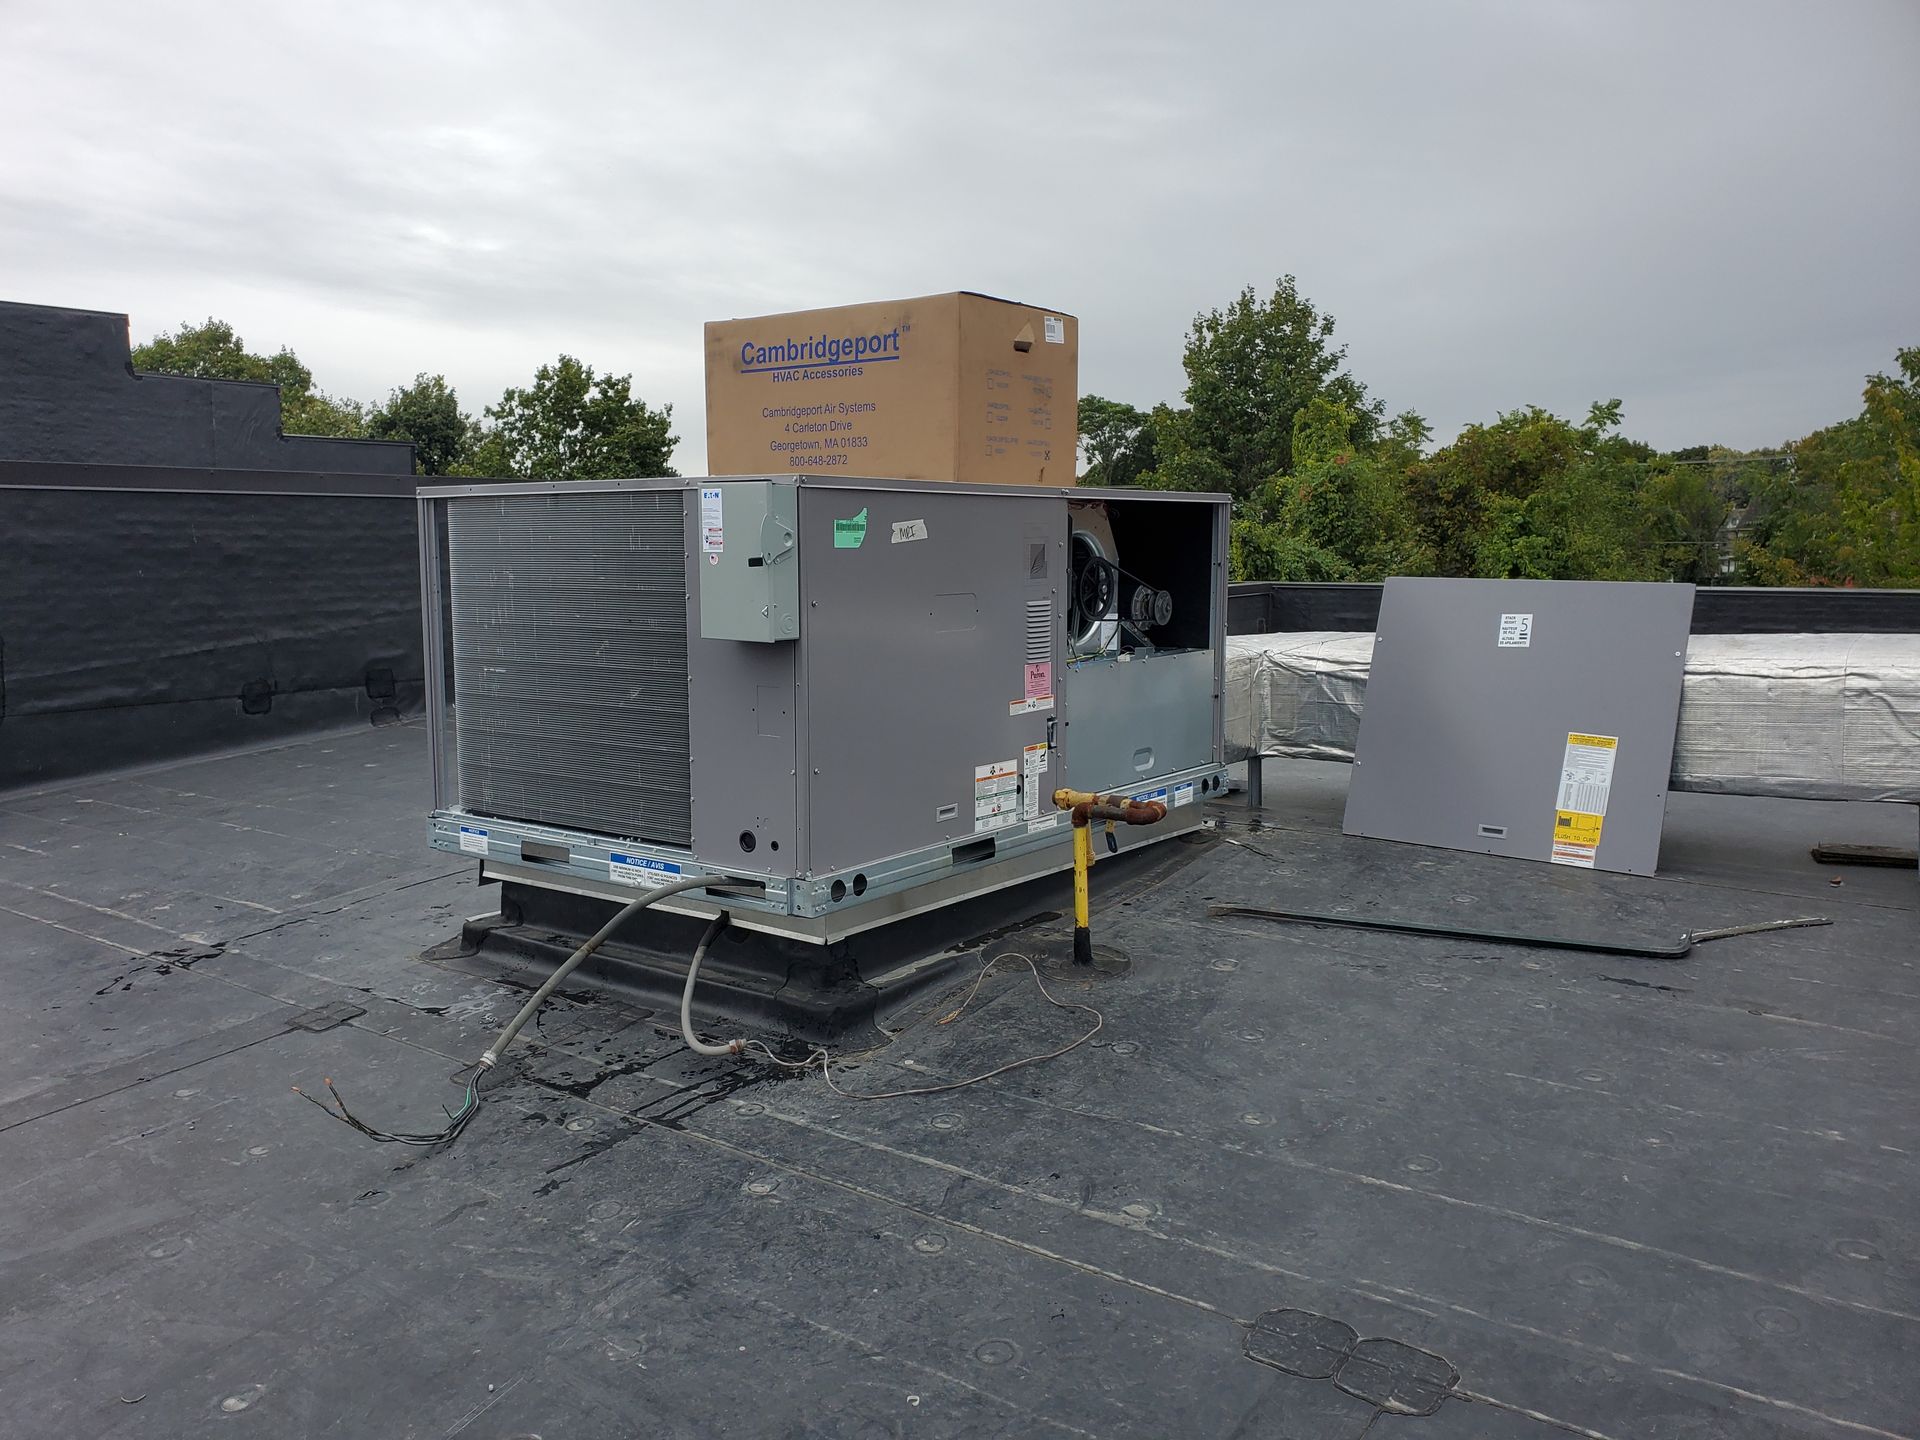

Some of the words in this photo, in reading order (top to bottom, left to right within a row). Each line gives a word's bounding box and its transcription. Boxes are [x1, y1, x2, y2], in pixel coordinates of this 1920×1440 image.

[741, 328, 900, 364] Cambridgeport
[772, 370, 800, 383] HVAC
[802, 366, 863, 381] Accessories
[762, 404, 823, 419] Cambridgeport
[824, 403, 836, 414] Air
[838, 402, 876, 416] Systems
[784, 423, 790, 432] 4
[792, 422, 828, 433] Carleton
[829, 420, 853, 431] Drive
[770, 440, 822, 453] Georgetown,
[824, 438, 839, 449] MA
[840, 436, 868, 448] 01833
[789, 454, 848, 467] 800-648-2872
[1520, 617, 1528, 632] 5
[626, 857, 647, 867] NOTICE
[650, 861, 665, 870] AVIS
